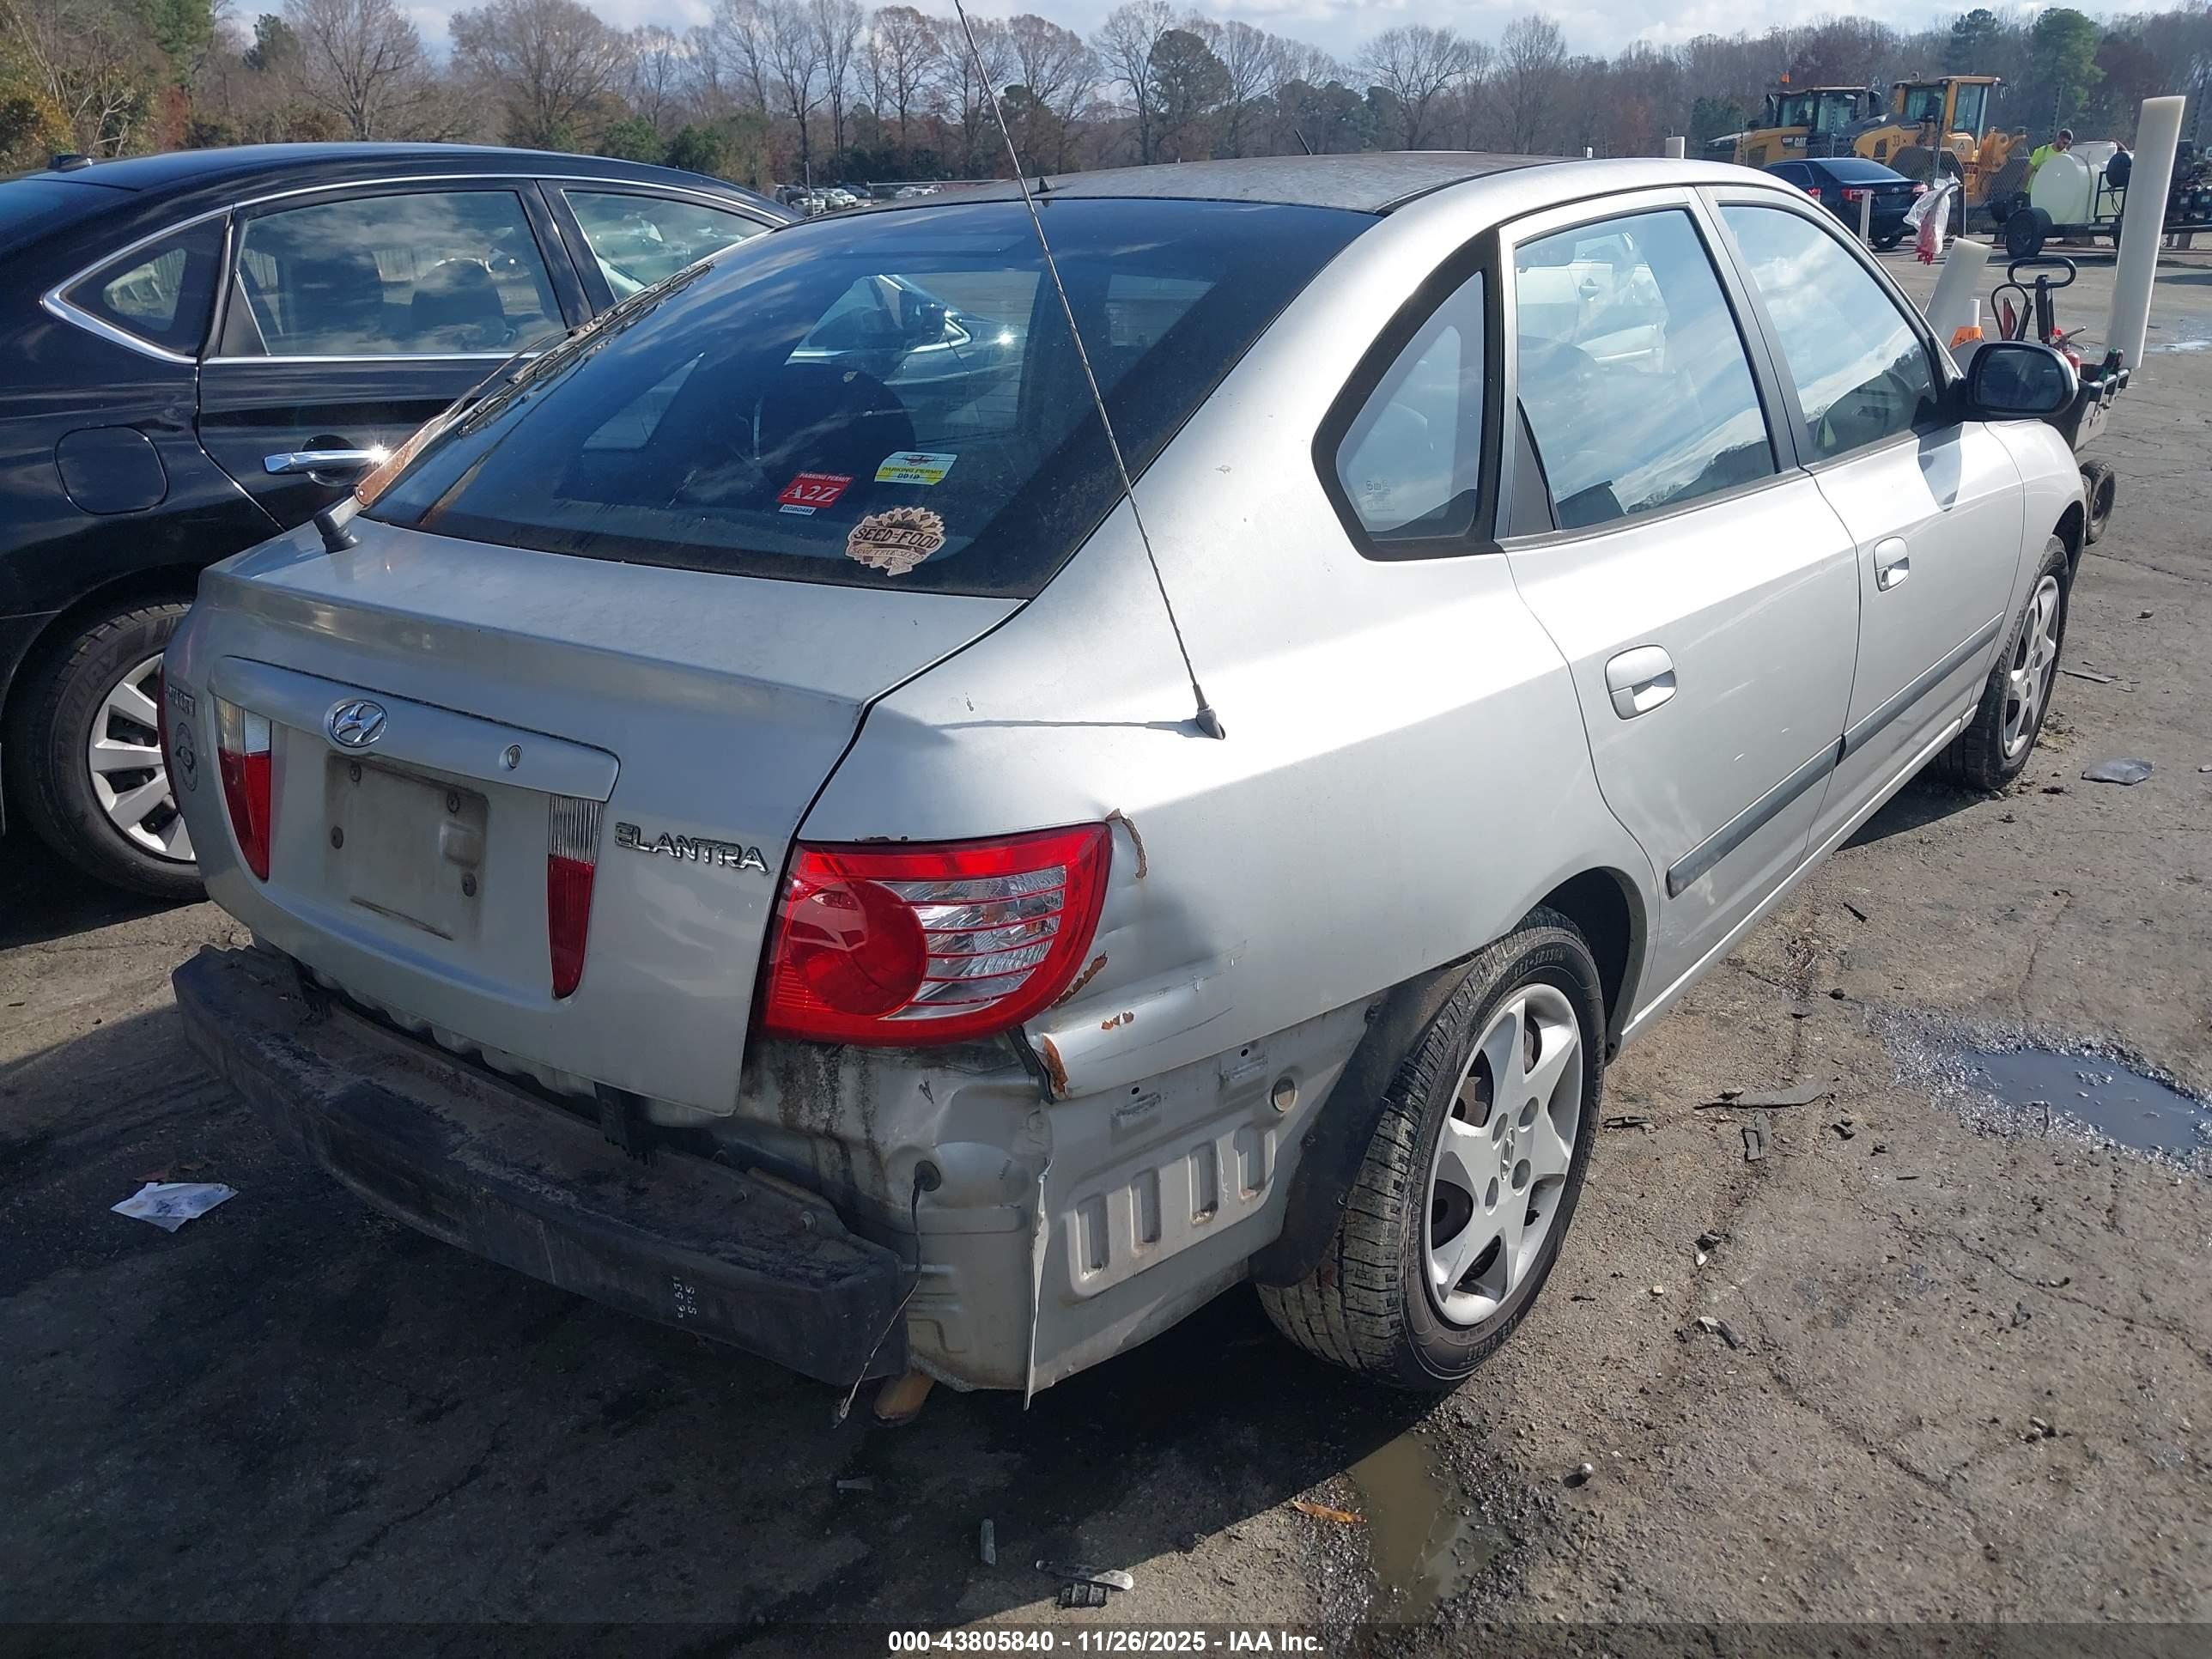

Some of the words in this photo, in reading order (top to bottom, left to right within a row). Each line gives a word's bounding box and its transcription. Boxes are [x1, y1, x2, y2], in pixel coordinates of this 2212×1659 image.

[1794, 137, 1808, 147] CAT
[799, 472, 827, 481] PARKING
[782, 483, 841, 502] A2Z
[614, 821, 769, 875] ELANTRA
